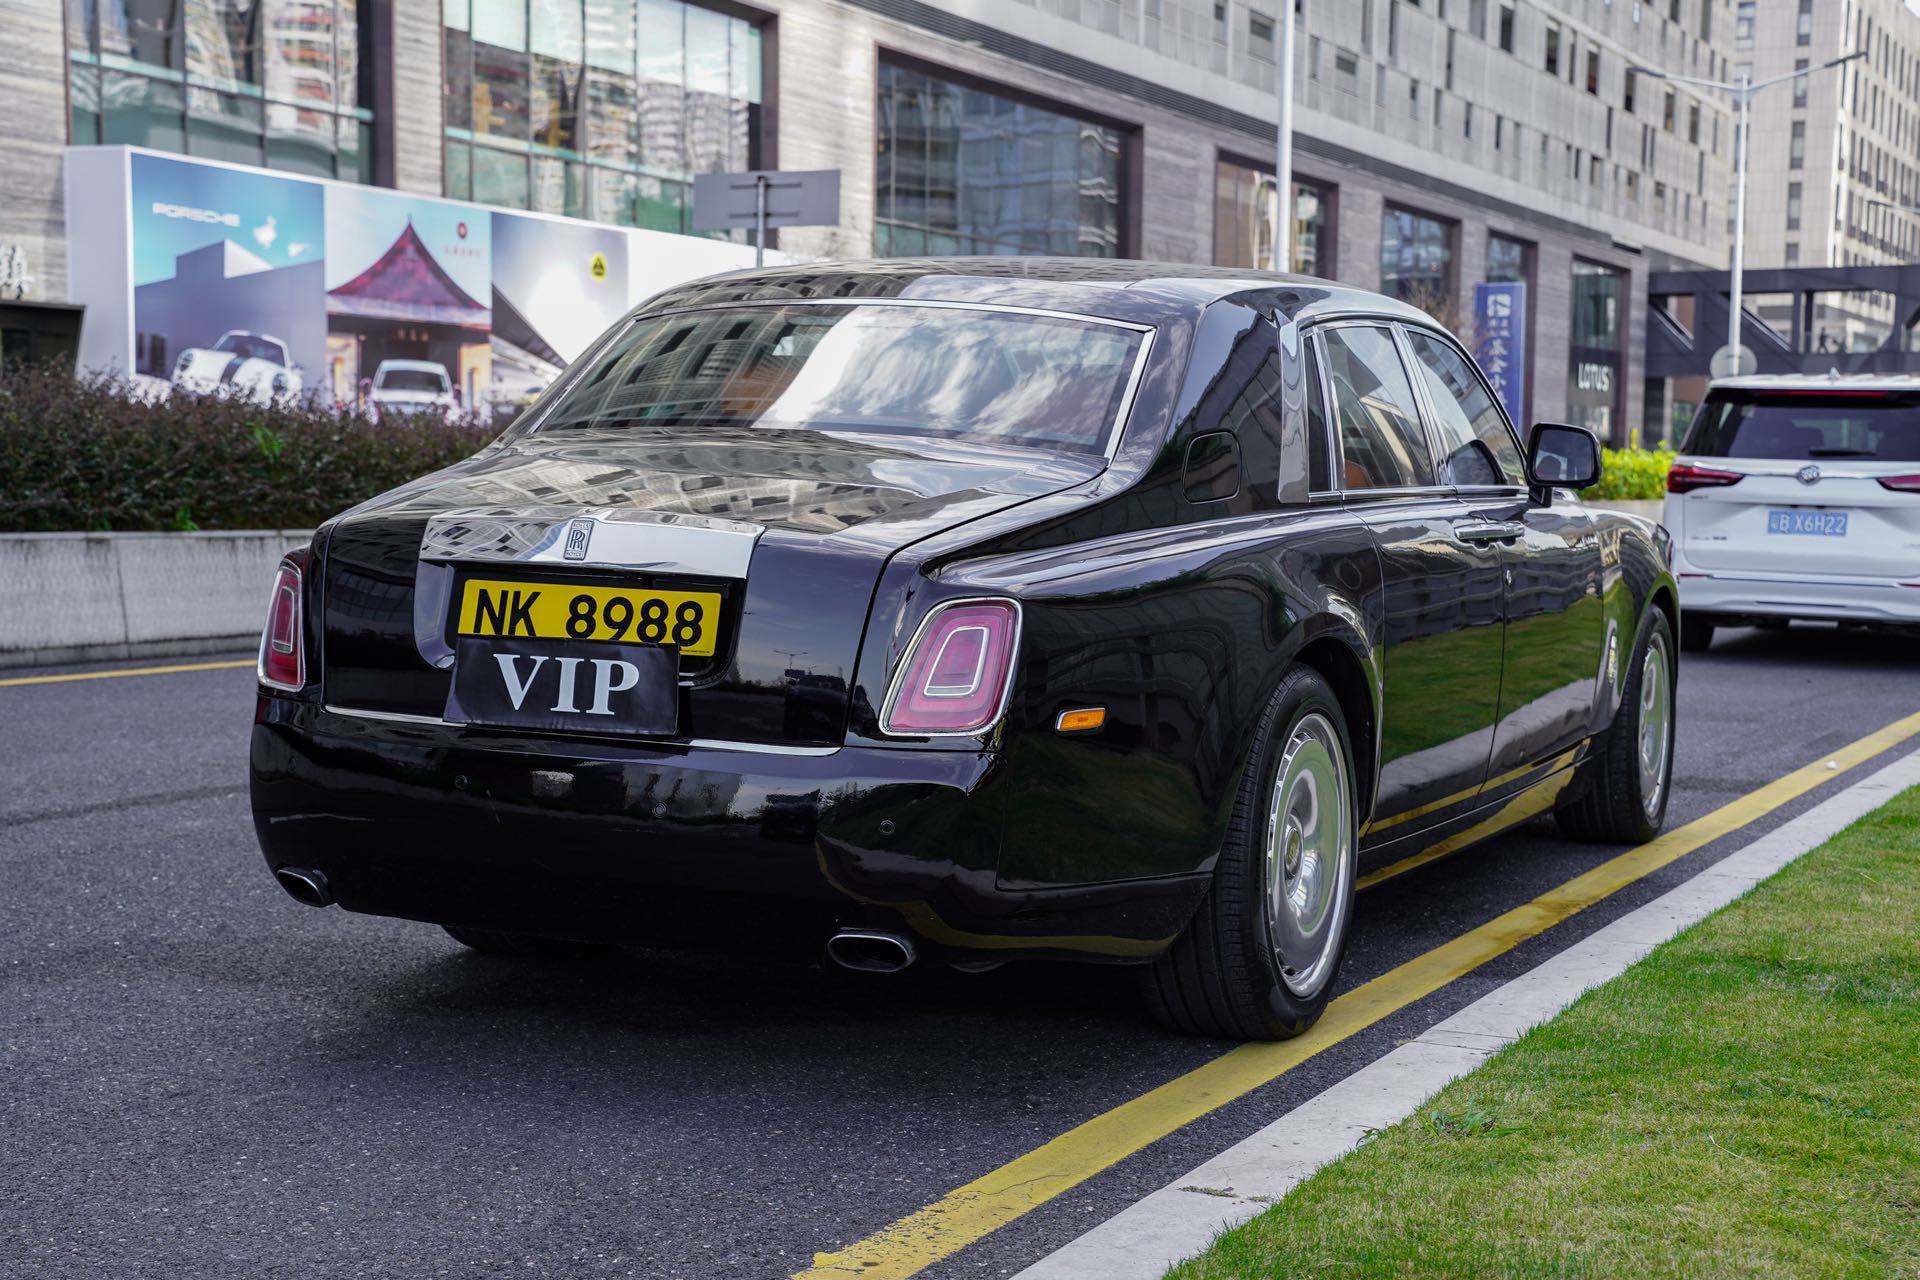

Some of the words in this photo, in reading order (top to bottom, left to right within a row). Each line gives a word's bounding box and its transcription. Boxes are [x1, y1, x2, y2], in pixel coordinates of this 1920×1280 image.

[1578, 362, 1610, 392] LOTUS
[472, 588, 542, 637] NK
[565, 594, 704, 647] 8988
[493, 653, 640, 716] VIP
